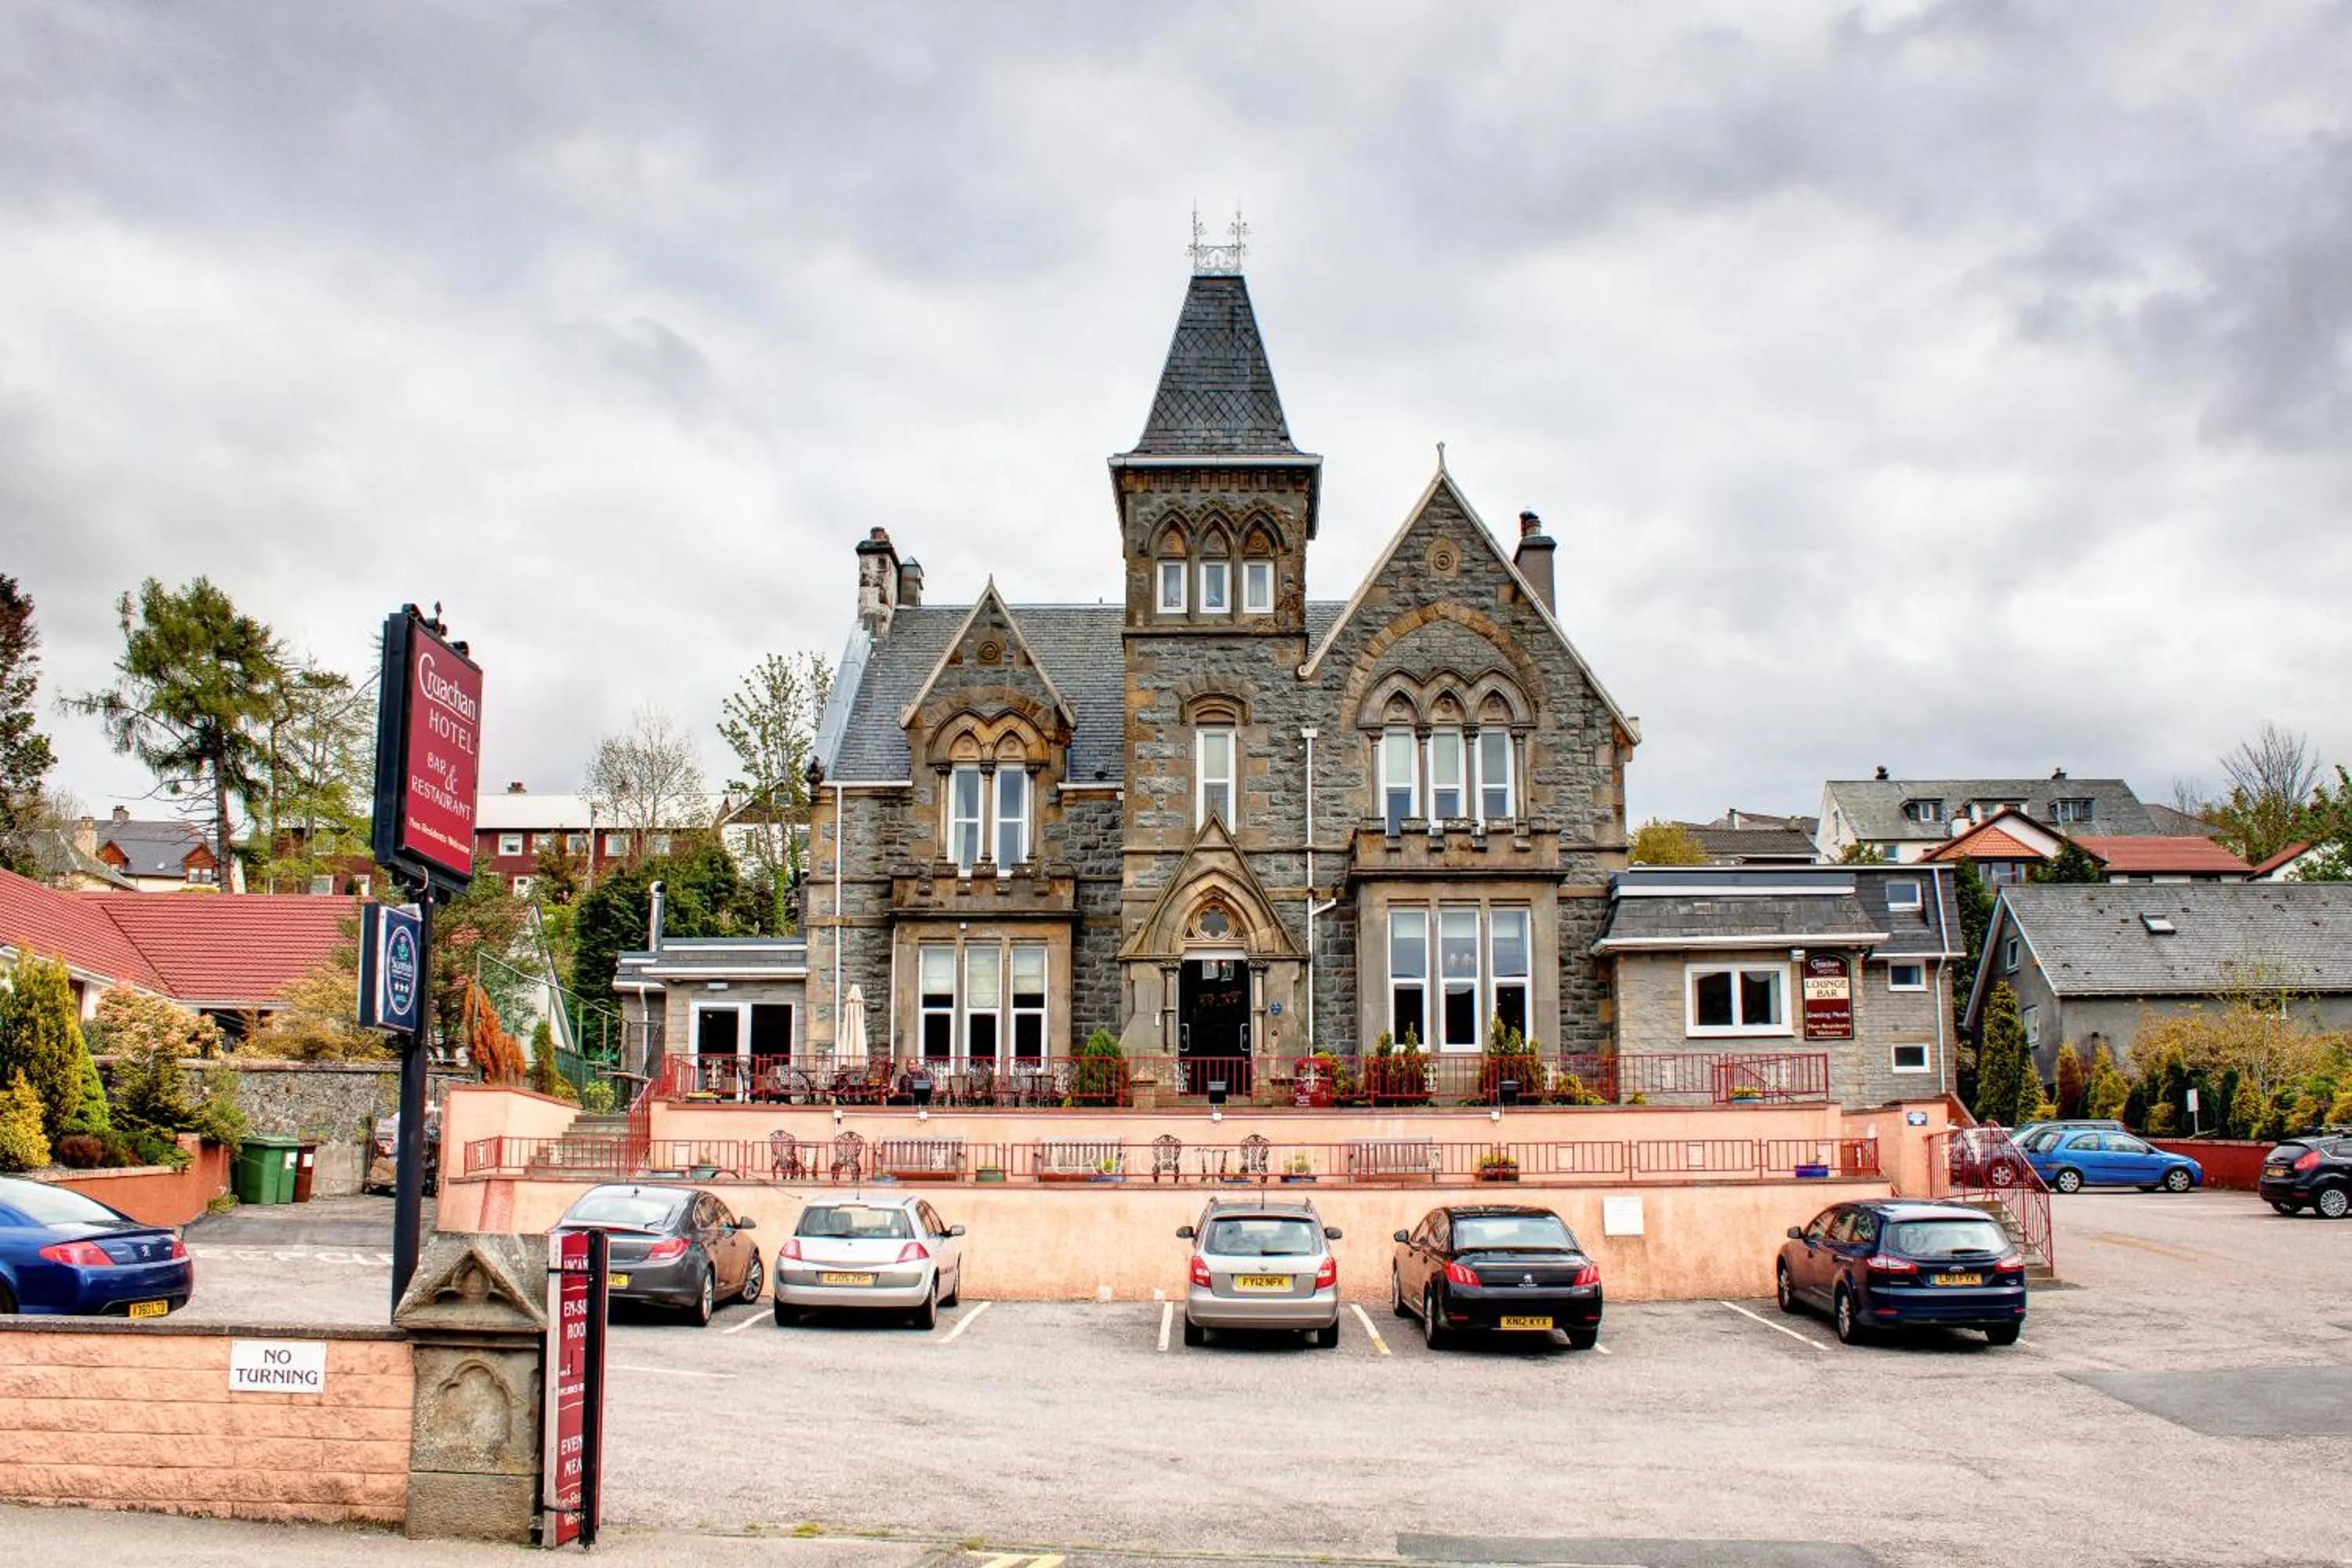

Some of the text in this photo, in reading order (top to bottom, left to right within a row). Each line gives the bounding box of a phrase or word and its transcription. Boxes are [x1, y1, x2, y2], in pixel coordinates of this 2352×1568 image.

[419, 652, 476, 723] Cruachan
[429, 708, 474, 755] HOTEL
[412, 775, 471, 821] RESTAURANT
[1806, 979, 1847, 989] LOUNGE
[1243, 1277, 1264, 1287] FY12
[263, 1349, 292, 1364] NO
[235, 1368, 318, 1385] TURNING
